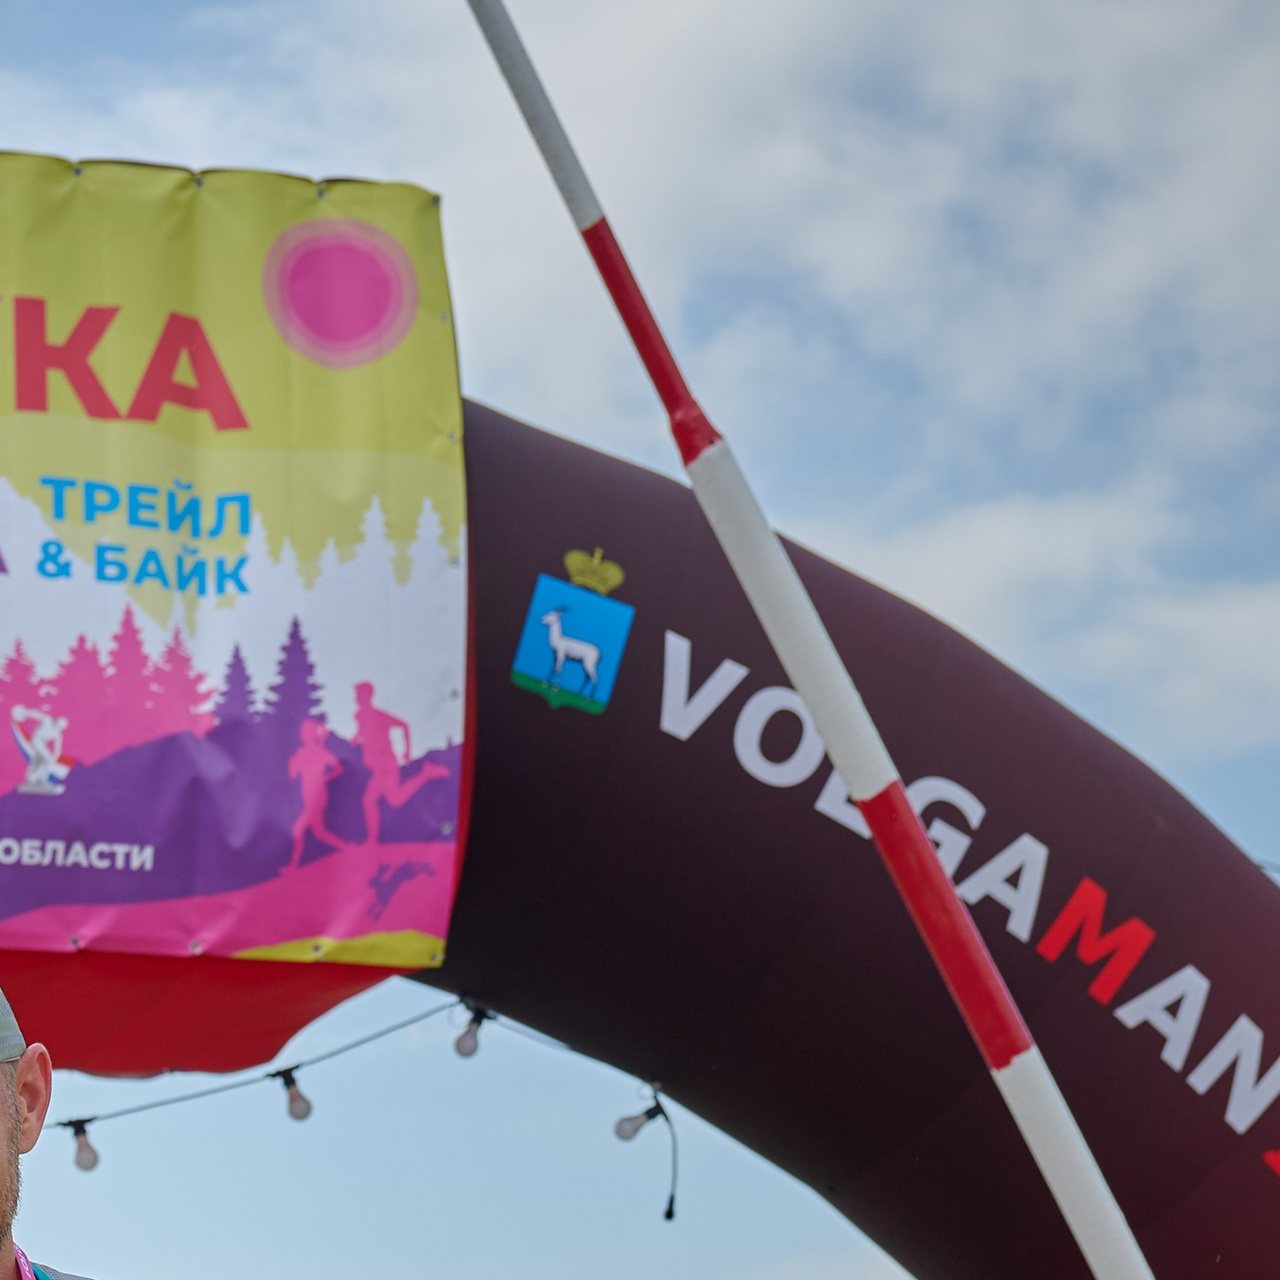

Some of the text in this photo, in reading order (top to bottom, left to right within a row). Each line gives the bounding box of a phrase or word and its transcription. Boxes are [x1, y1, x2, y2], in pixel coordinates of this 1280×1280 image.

[40, 475, 252, 538] ТРЕЙЛ
[36, 541, 250, 597] & БАЙК
